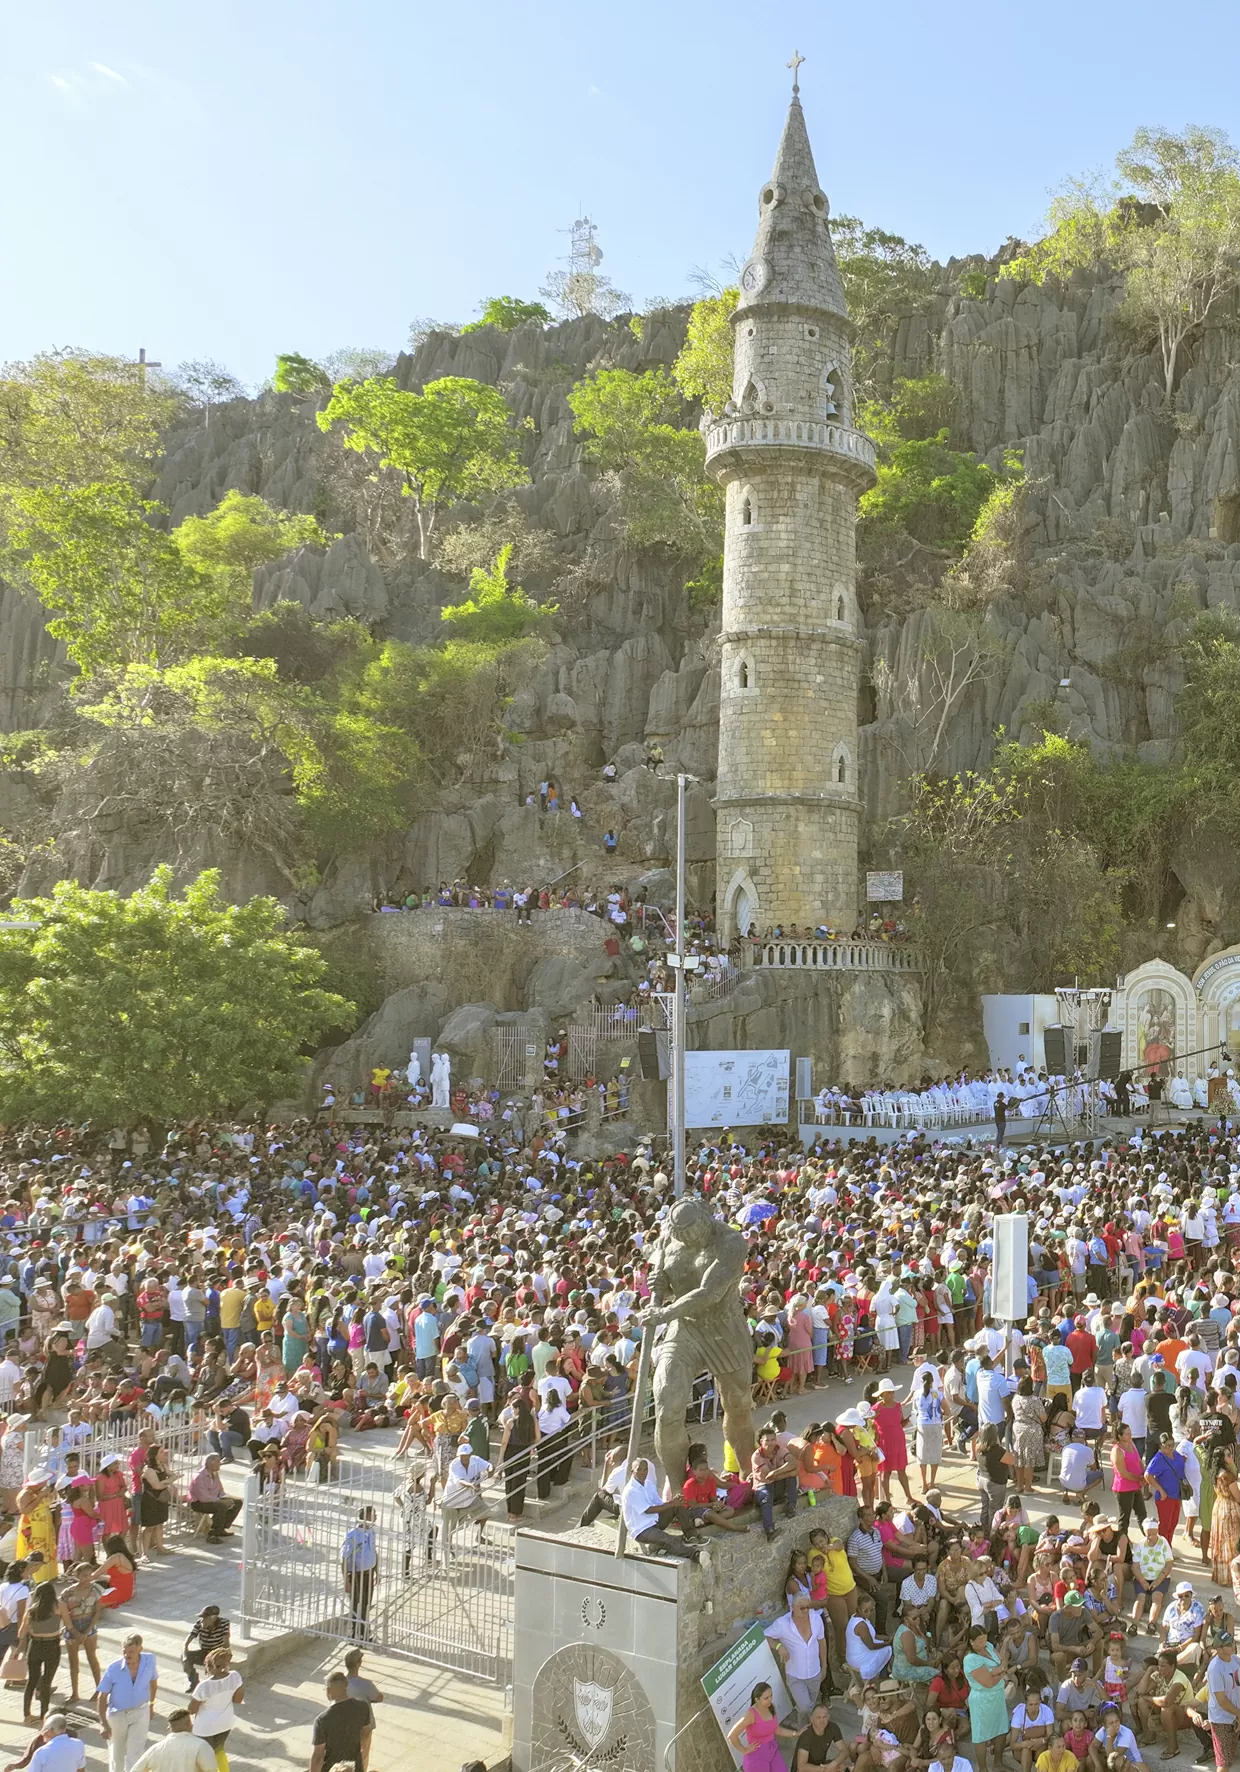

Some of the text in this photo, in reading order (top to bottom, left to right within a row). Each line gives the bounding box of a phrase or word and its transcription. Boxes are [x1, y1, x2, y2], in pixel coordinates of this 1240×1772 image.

[715, 1665, 734, 1684] LUGAR
[732, 1639, 757, 1666] SAGRADO
[719, 1640, 749, 1672] ESPLANADA
